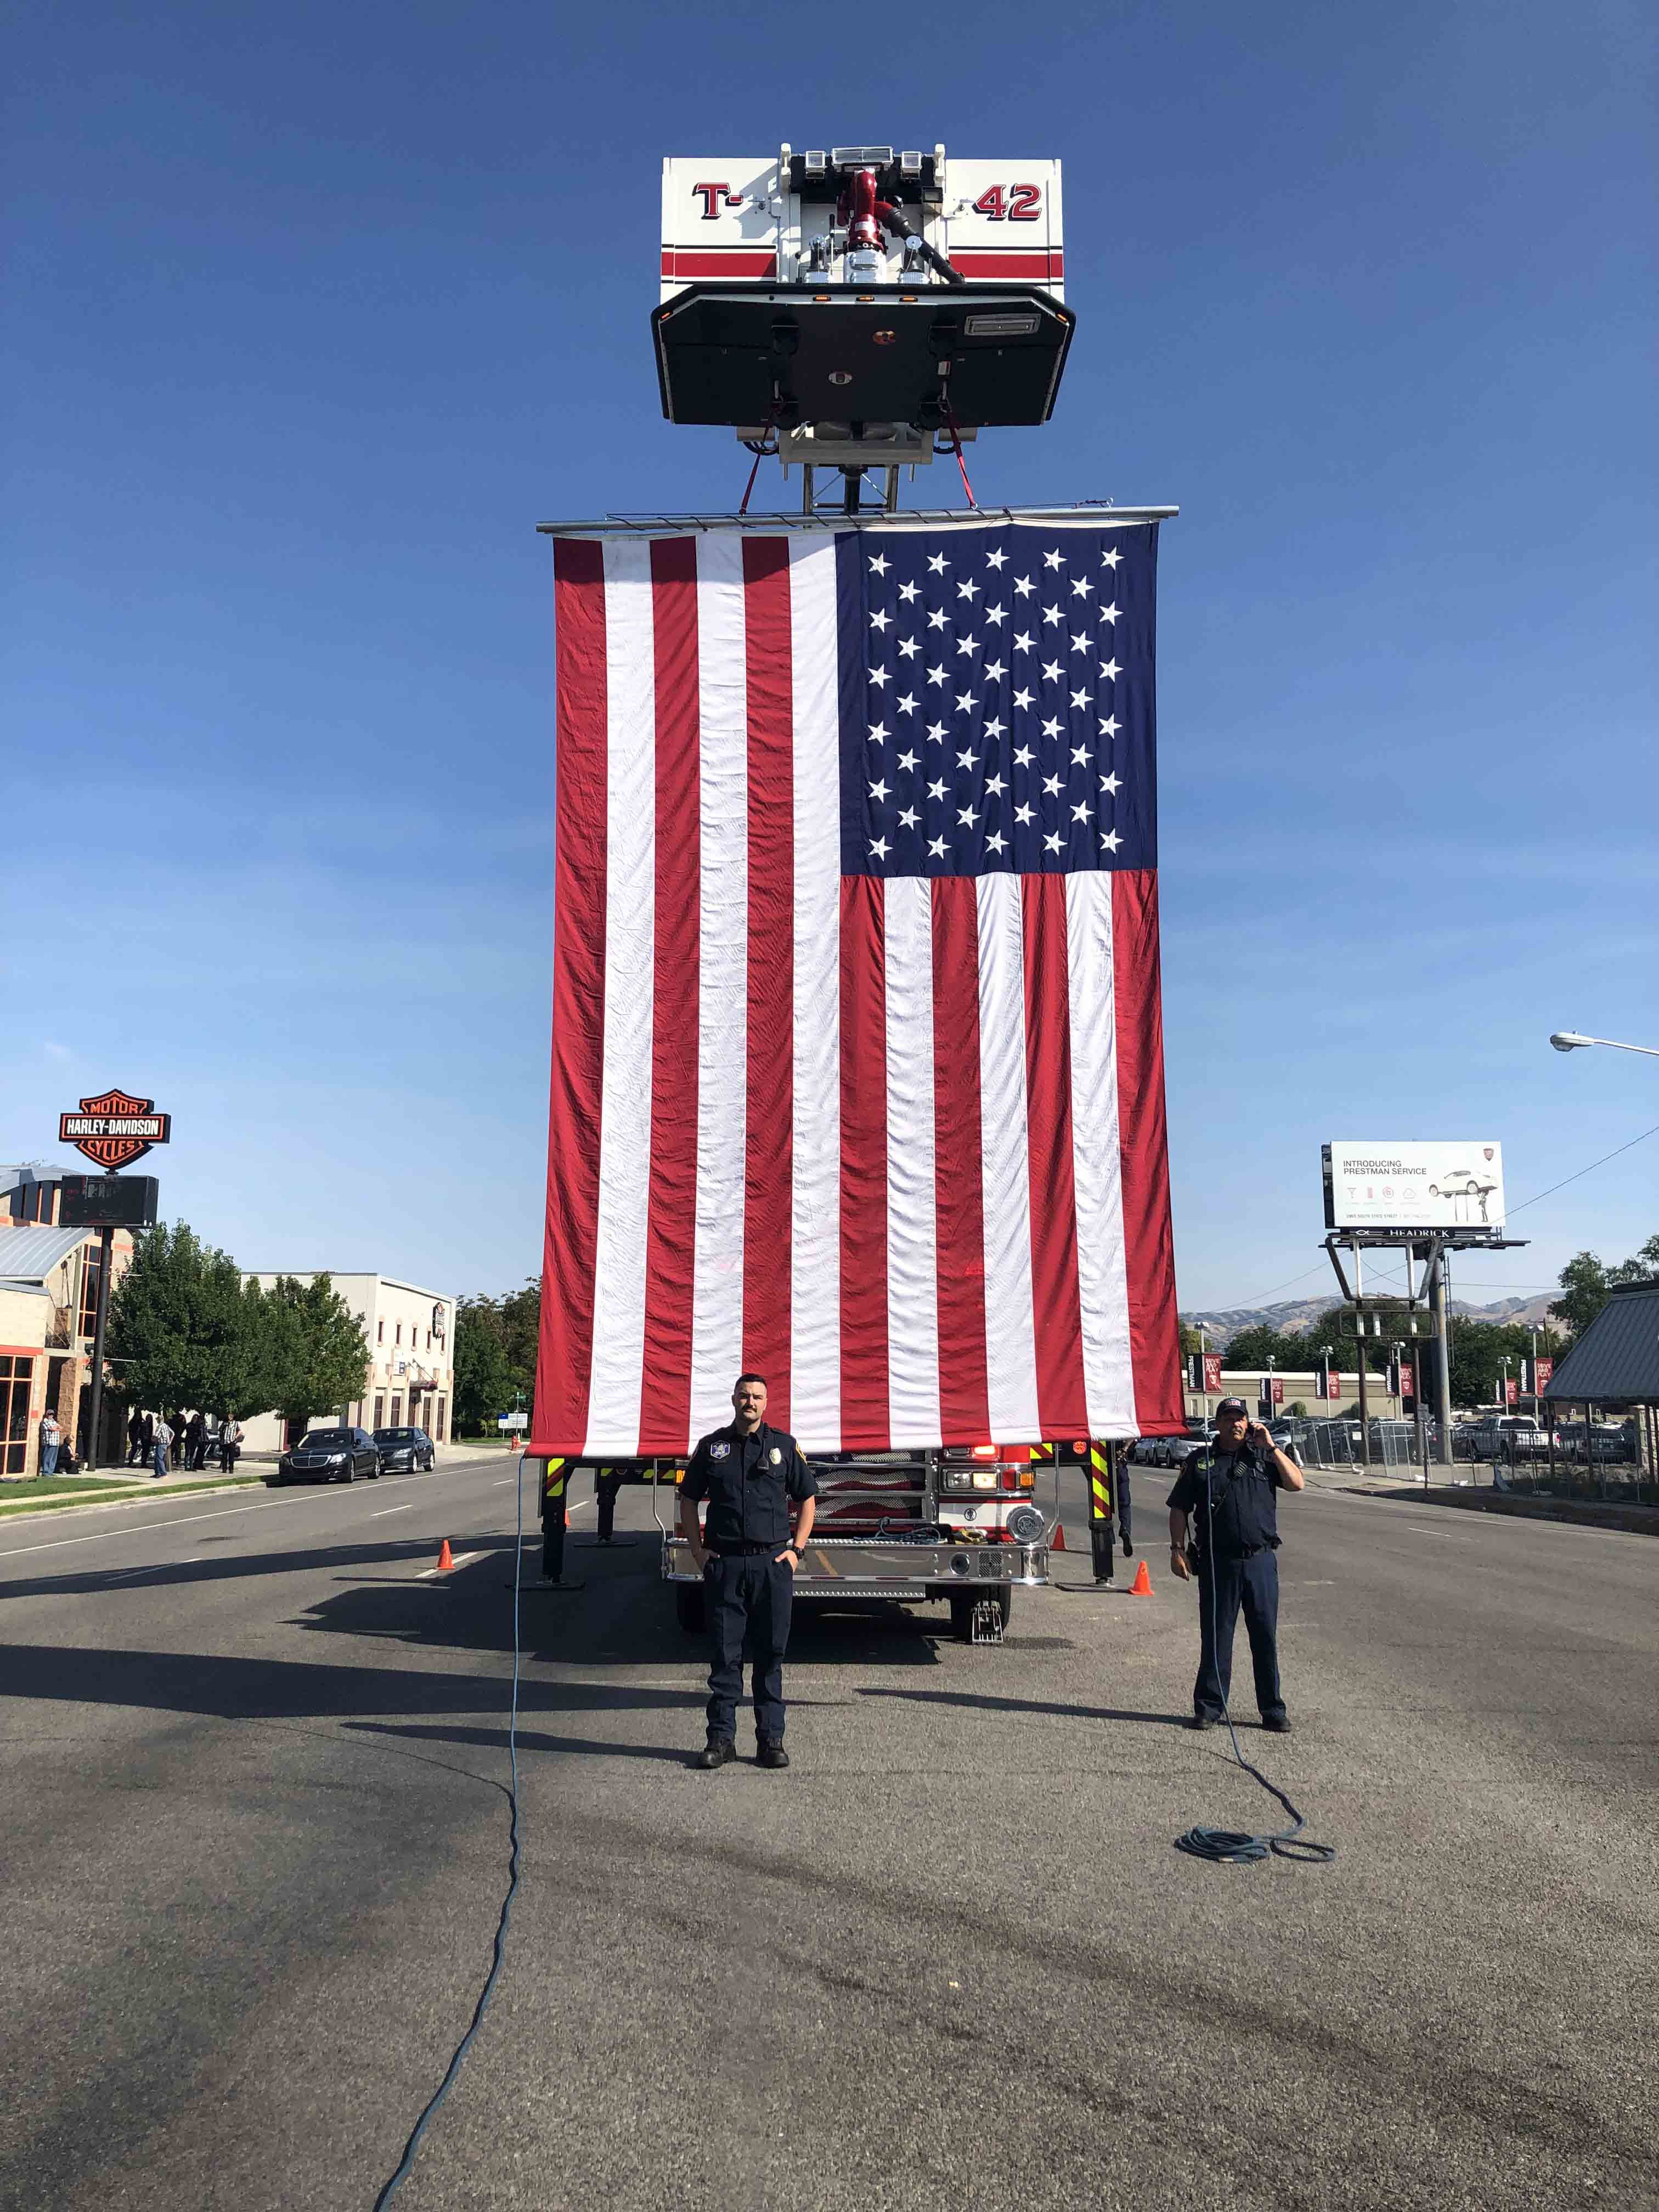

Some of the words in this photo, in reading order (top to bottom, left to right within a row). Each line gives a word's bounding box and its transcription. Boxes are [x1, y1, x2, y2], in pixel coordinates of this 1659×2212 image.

[692, 183, 743, 220] T-
[972, 183, 1042, 221] 42
[90, 1097, 138, 1114] MOTOR
[67, 1119, 159, 1135] HARLEY-DAVIDSON
[87, 1141, 136, 1160] CYCLES
[1390, 1229, 1449, 1237] HEADRICK
